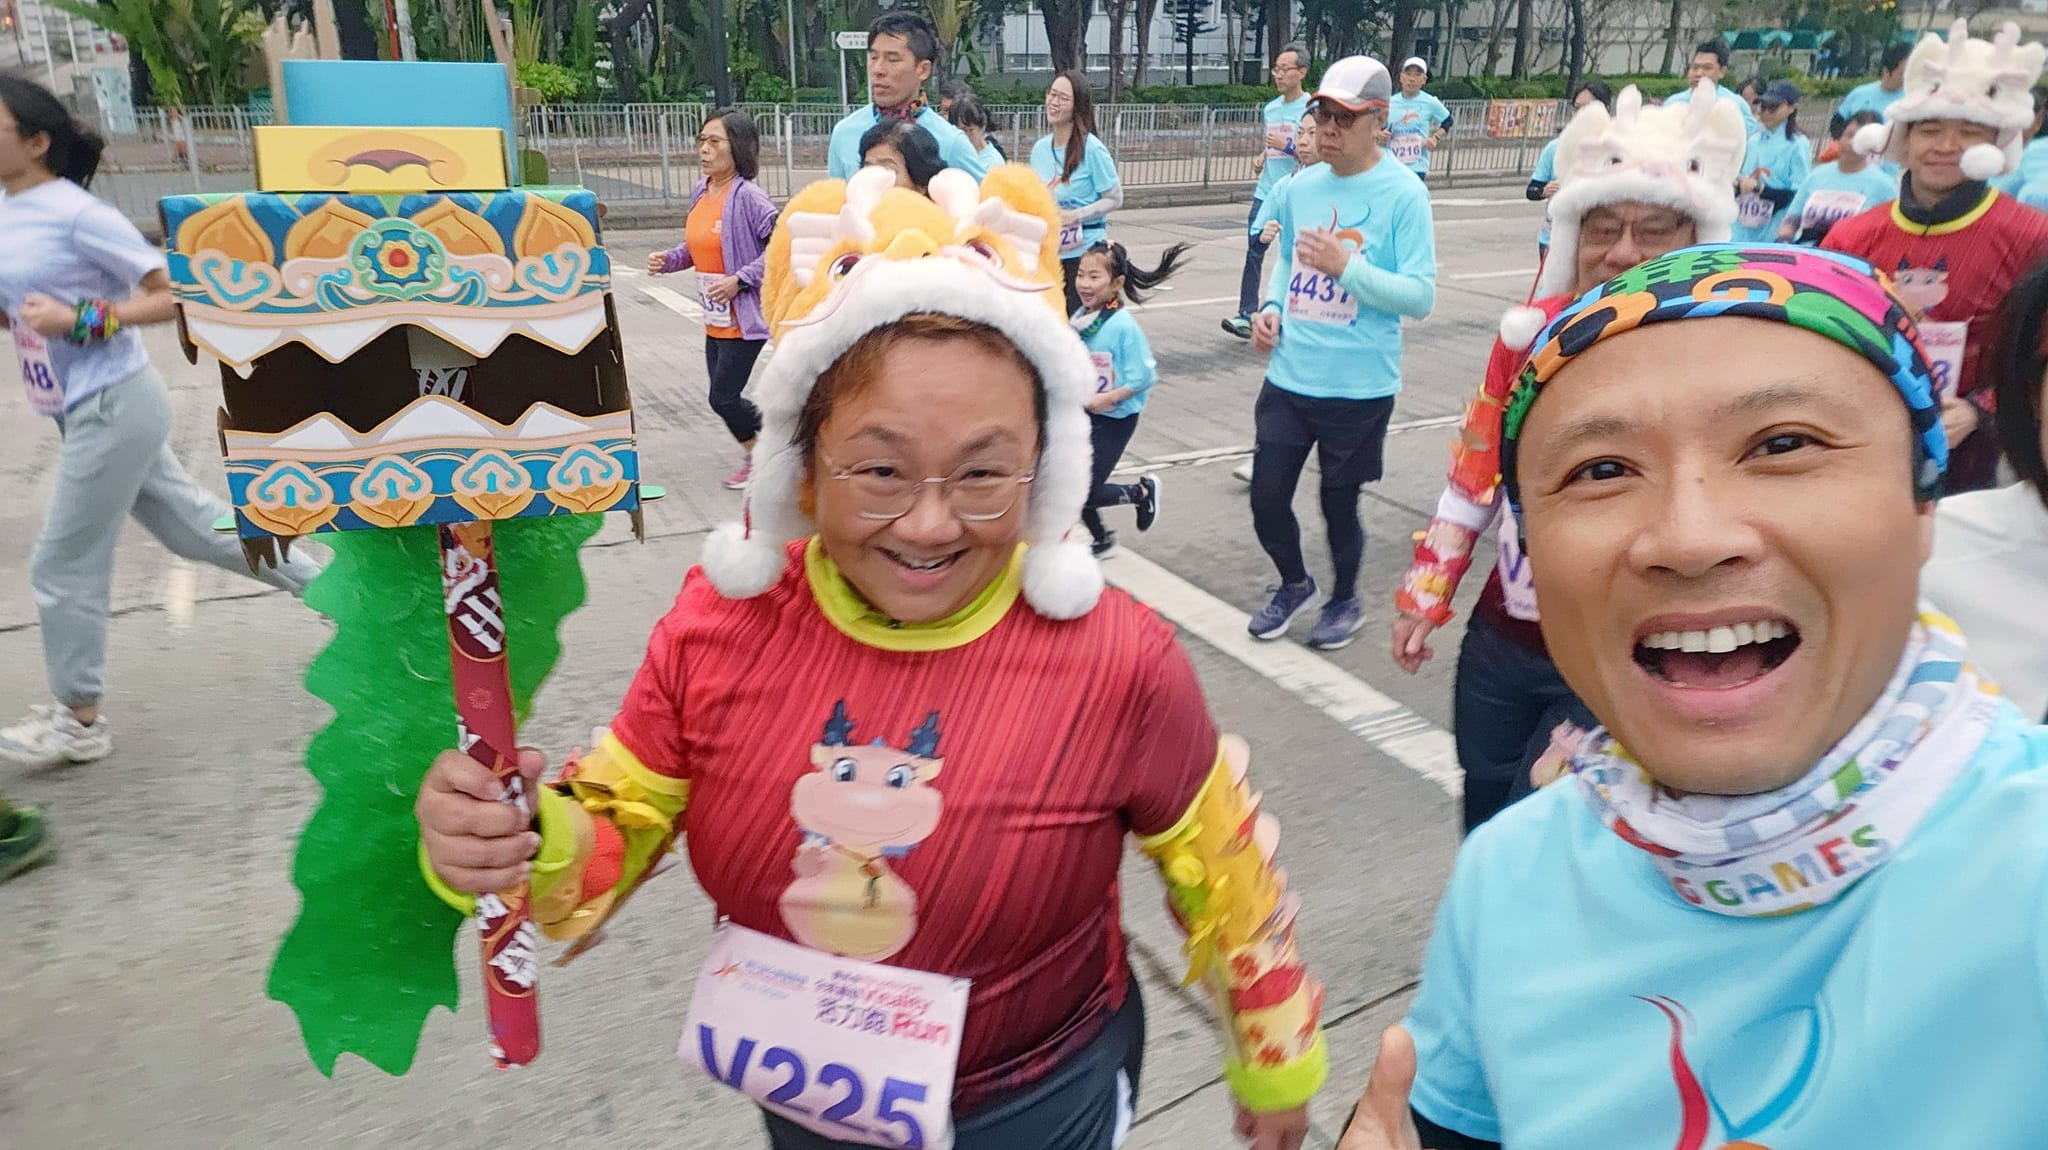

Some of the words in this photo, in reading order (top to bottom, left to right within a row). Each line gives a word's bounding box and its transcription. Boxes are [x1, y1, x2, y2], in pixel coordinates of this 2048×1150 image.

[1391, 145, 1421, 157] V216
[1704, 823, 1893, 907] GAMES
[699, 1021, 929, 1150] V225
